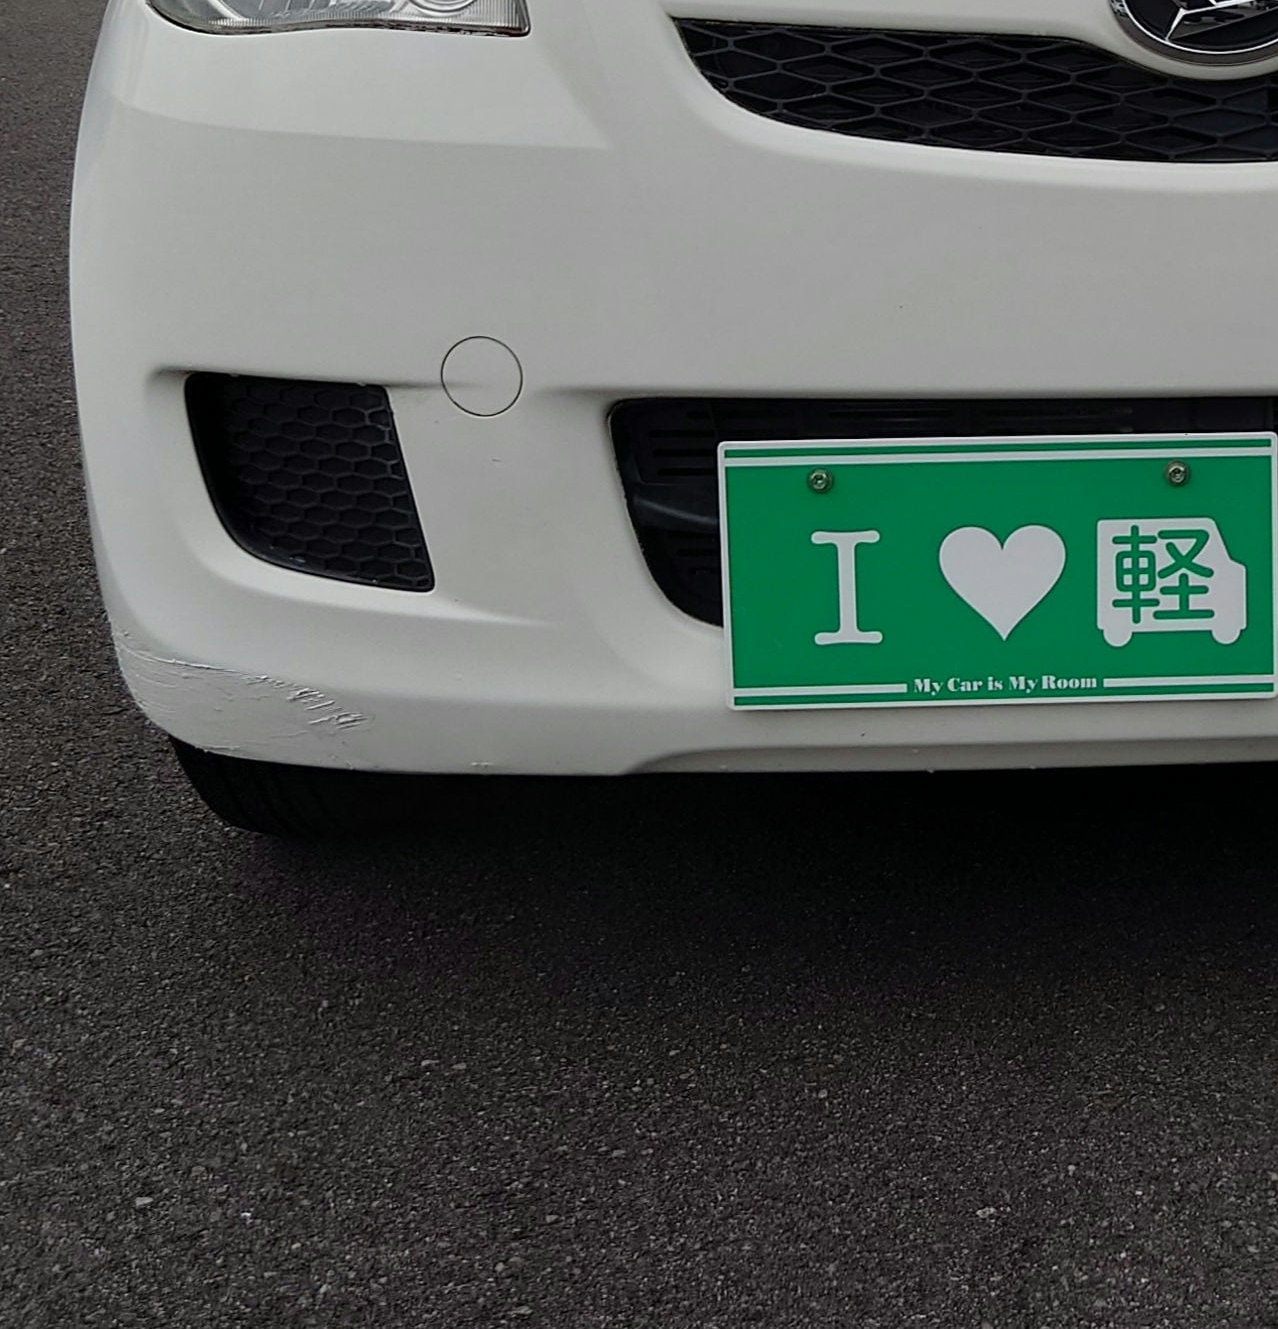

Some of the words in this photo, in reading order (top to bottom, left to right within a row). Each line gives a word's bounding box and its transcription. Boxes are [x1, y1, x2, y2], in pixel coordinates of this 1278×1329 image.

[811, 530, 883, 645] I
[1112, 524, 1215, 624] 軽
[913, 678, 943, 696] My
[947, 677, 983, 692] Car
[987, 676, 1003, 691] is
[1009, 675, 1038, 693] My
[1041, 675, 1097, 690] Room
